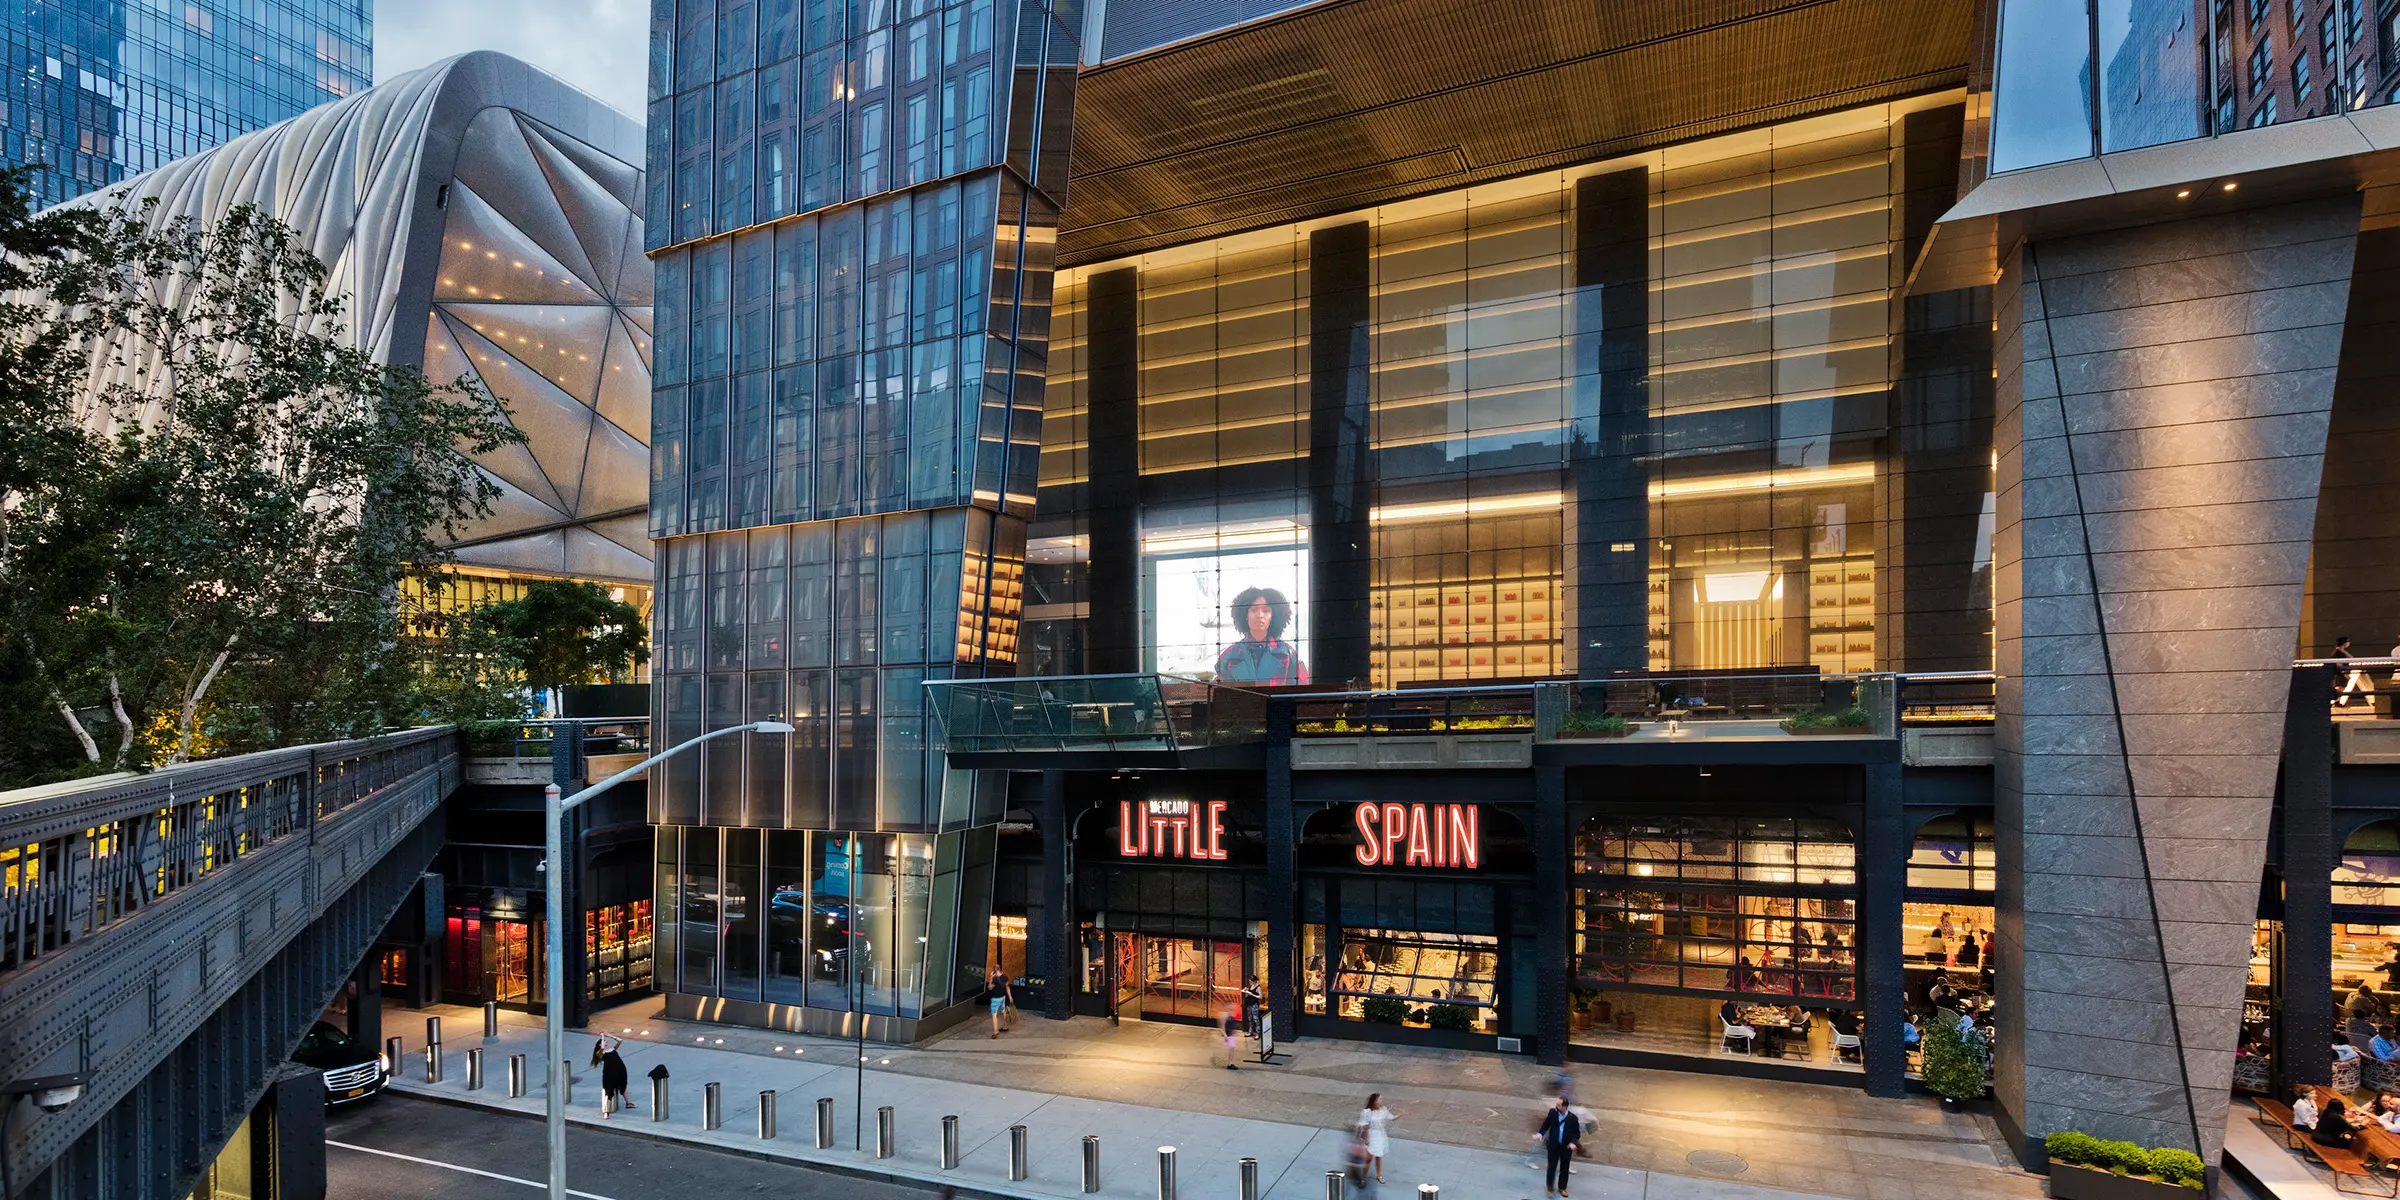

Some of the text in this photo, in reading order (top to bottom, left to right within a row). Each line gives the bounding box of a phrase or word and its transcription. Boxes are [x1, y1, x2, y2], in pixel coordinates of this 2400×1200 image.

[1150, 800, 1189, 814] MERCADO
[1120, 800, 1479, 869] LITTLE SPAIN
